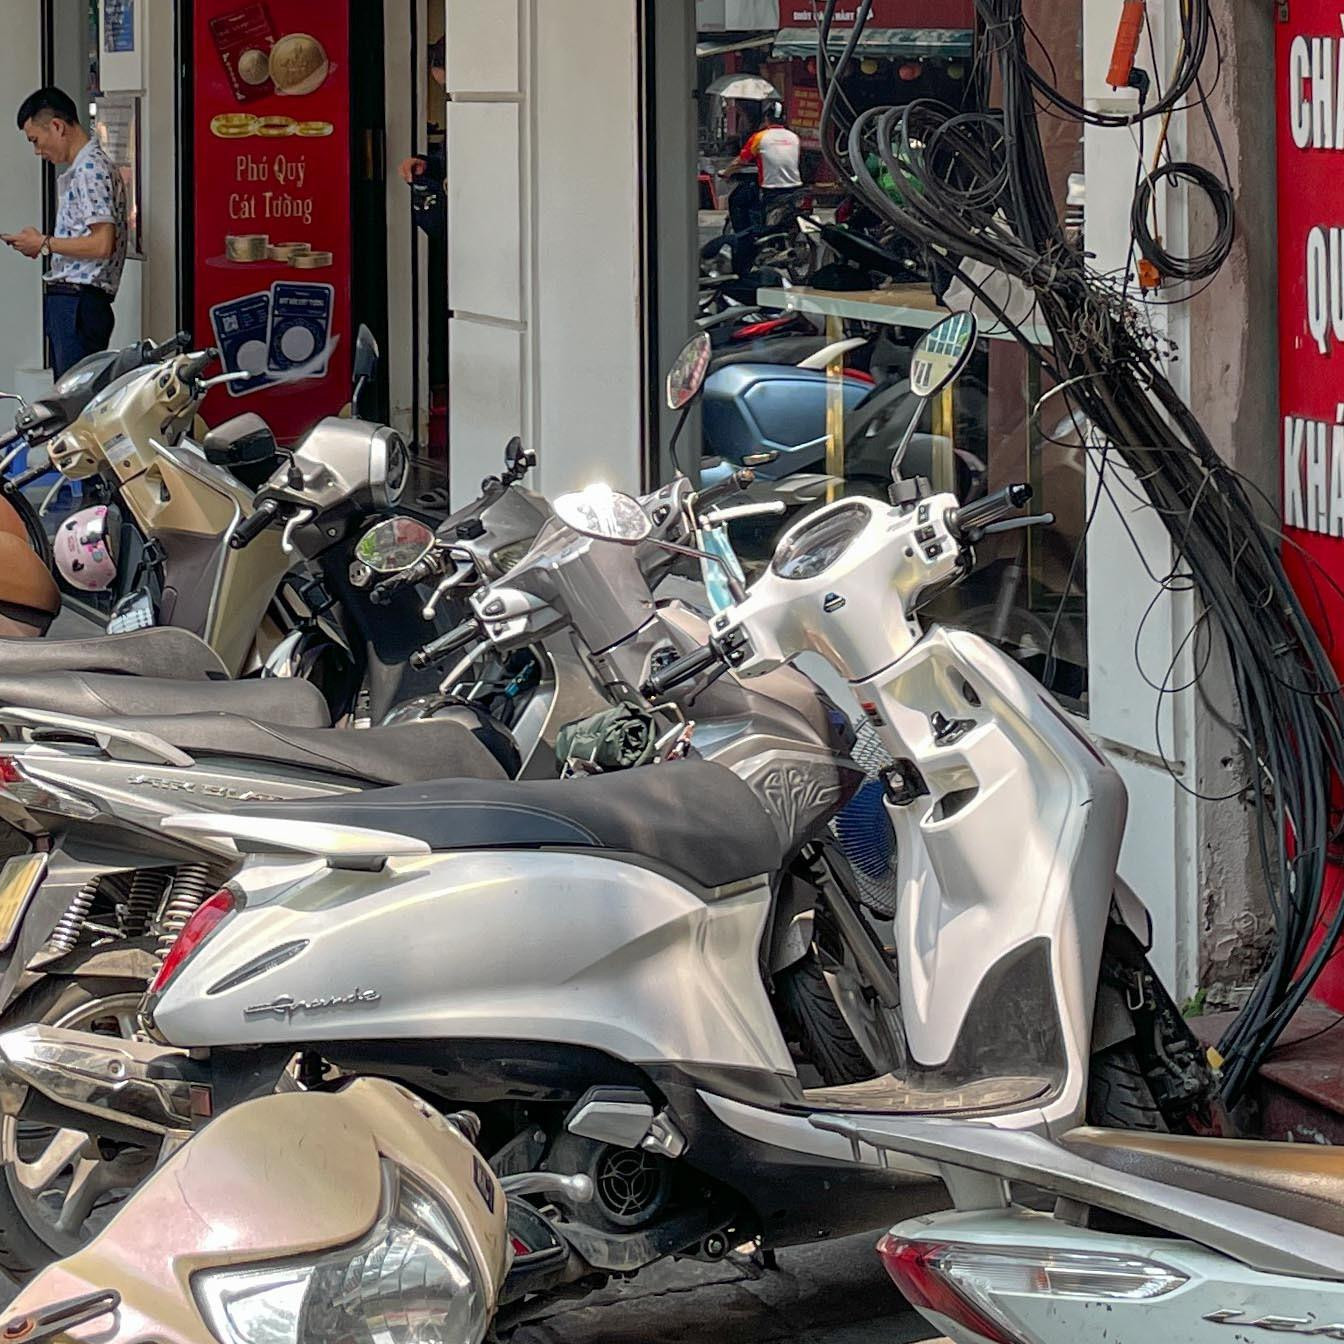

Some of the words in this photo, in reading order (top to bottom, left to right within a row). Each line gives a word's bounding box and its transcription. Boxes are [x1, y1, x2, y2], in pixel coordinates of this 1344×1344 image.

[236, 154, 267, 182] Phú
[273, 154, 306, 187] Quý
[229, 192, 256, 220] Cát
[264, 192, 313, 224] Tường
